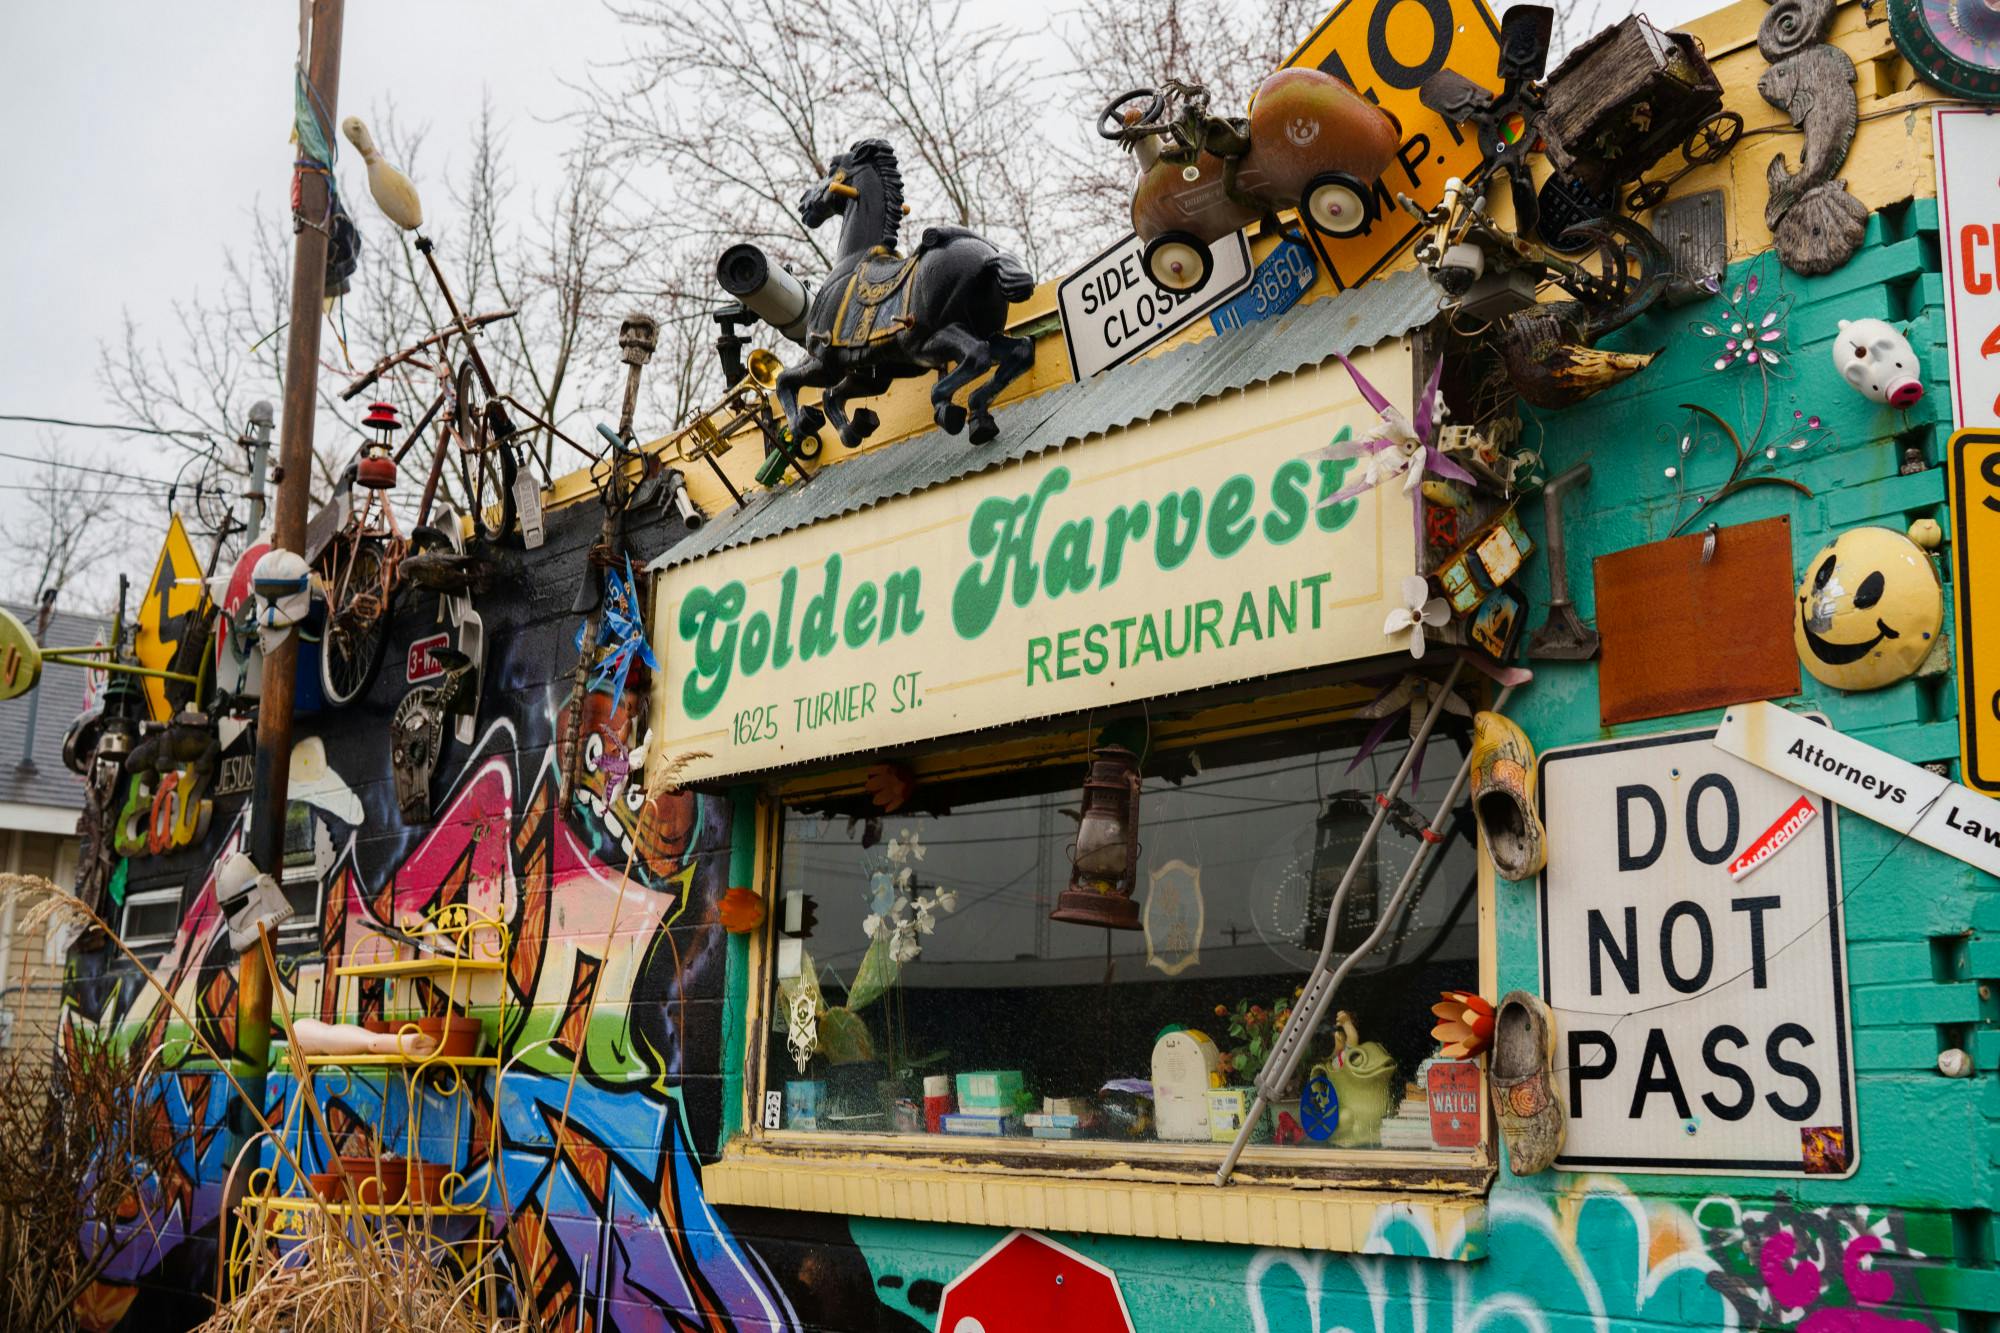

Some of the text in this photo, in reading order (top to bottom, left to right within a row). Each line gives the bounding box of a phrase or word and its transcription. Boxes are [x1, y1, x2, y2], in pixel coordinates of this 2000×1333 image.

[1081, 249, 1147, 315] SIDE
[679, 425, 1360, 720] Golden Harvest
[1026, 572, 1335, 688] RESTAURANT
[732, 671, 925, 747] 1625 TURNER ST.
[214, 755, 254, 791] JESUS
[1787, 738, 1907, 804] Attorneys
[1617, 773, 1741, 872] DO
[1587, 895, 1781, 996] NOT
[1432, 1091, 1477, 1113] WATCH
[1568, 1022, 1821, 1122] PASS
